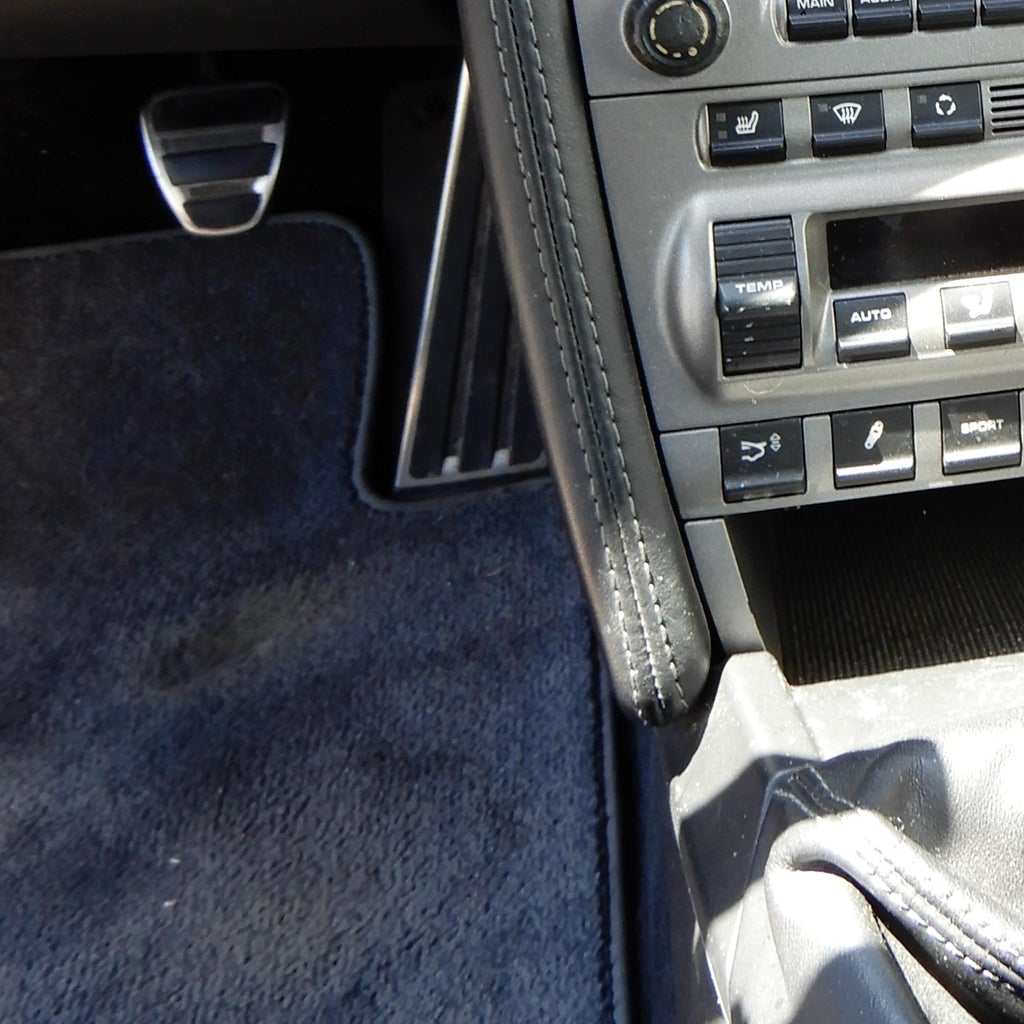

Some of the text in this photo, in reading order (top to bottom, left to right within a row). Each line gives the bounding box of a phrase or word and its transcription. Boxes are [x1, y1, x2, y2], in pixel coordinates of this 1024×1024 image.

[735, 279, 785, 294] TEMP
[850, 308, 893, 323] AUTO
[960, 418, 1004, 435] SPORT
